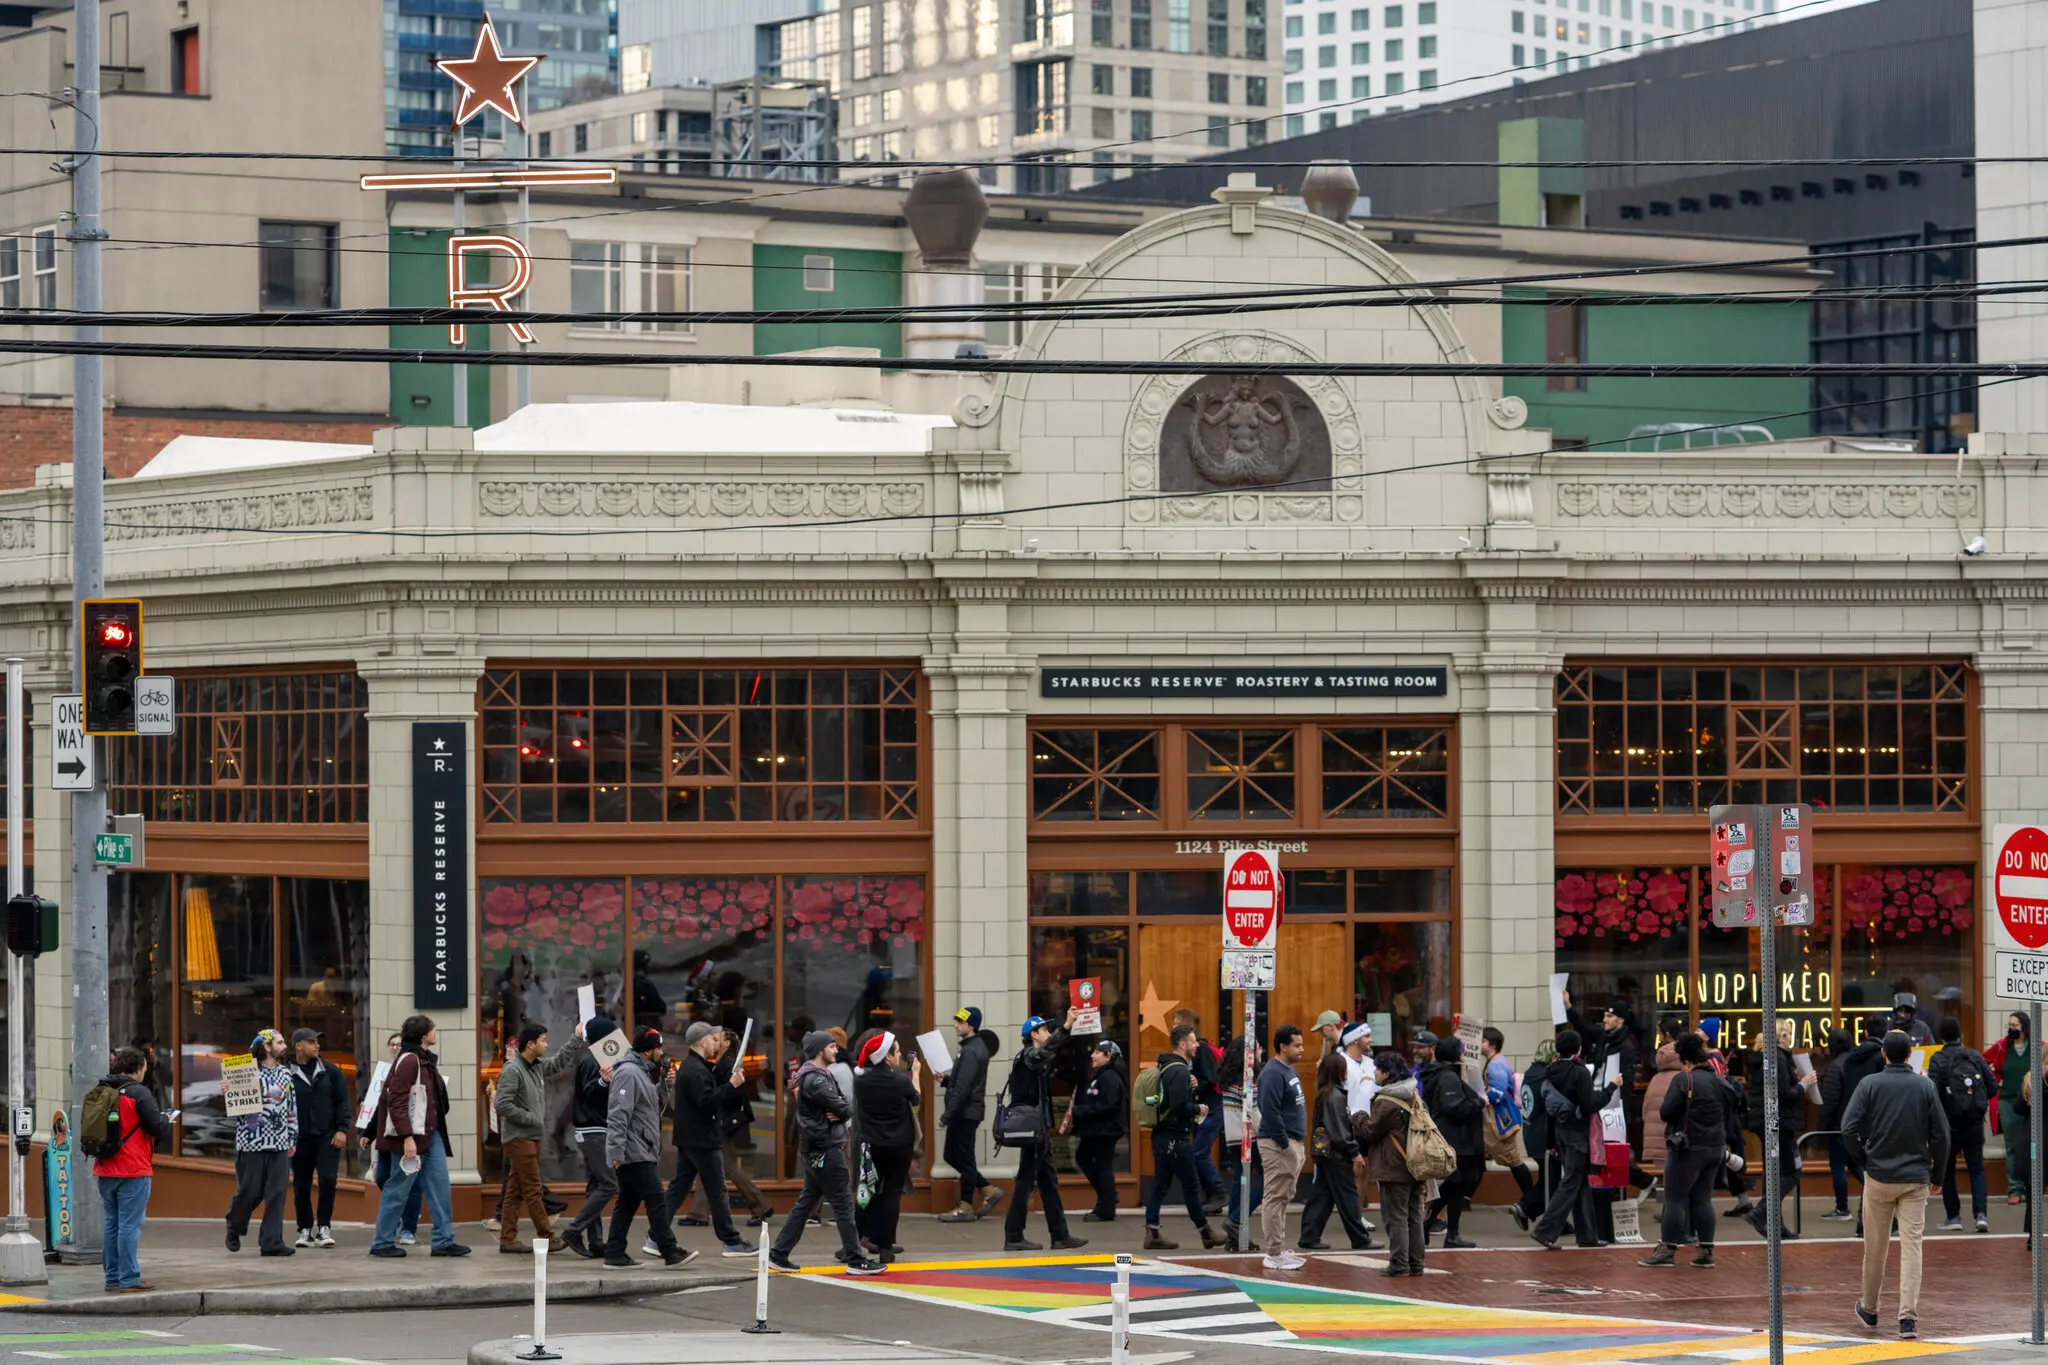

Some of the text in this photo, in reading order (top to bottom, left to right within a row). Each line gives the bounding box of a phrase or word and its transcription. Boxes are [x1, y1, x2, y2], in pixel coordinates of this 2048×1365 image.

[447, 235, 538, 345] R
[1051, 677, 1141, 688] STARBUCKS
[1236, 676, 1309, 687] ROASTERY
[1314, 676, 1324, 687] &
[1329, 675, 1389, 687] TASTING
[1394, 675, 1437, 687] ROOM
[139, 713, 170, 723] SIGNAL
[57, 728, 86, 749] WAY
[434, 759, 445, 772] R
[104, 836, 116, 858] Pike
[1175, 841, 1212, 854] 1124
[1257, 840, 1308, 853] Street
[2005, 850, 2048, 871] DO NO
[1232, 870, 1269, 885] DO NOT
[435, 800, 446, 991] STARBUCKS RESERVE
[1235, 913, 1264, 928] ENTER
[1655, 973, 1830, 1004] HANDPIKED
[2007, 978, 2048, 996] BICYCLE
[227, 1097, 260, 1107] STRIKE
[57, 1155, 70, 1236] TATTOO
